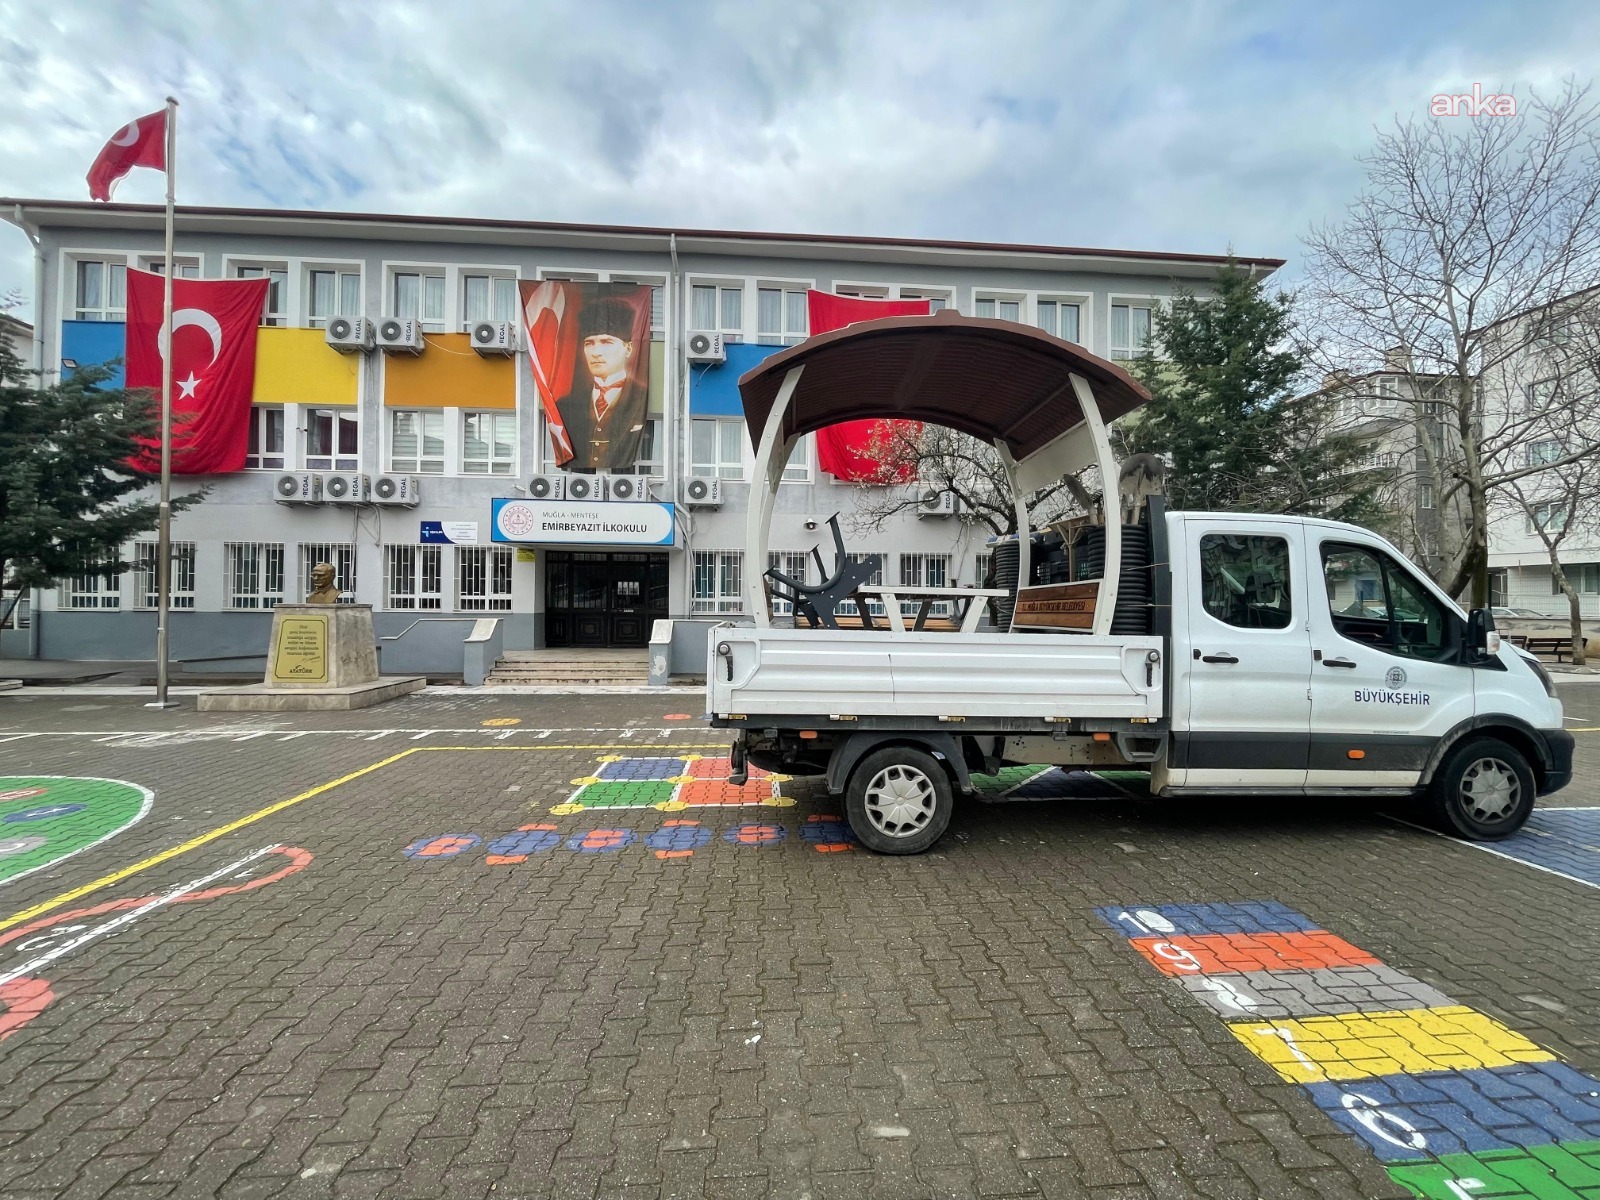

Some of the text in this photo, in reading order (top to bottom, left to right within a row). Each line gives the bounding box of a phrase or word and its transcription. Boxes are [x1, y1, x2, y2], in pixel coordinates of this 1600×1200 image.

[542, 510, 566, 519] MUĞLA
[571, 512, 599, 520] MENTEŞE
[542, 521, 648, 533] EMİRBEYAZIT İLKOKULU
[1354, 687, 1431, 706] BÜYÜKŞEHİR
[1117, 908, 1176, 933] 10
[1153, 942, 1203, 970] 9
[1202, 978, 1258, 1013] 8
[1255, 1027, 1318, 1071] 7
[1341, 1092, 1428, 1150] 6
